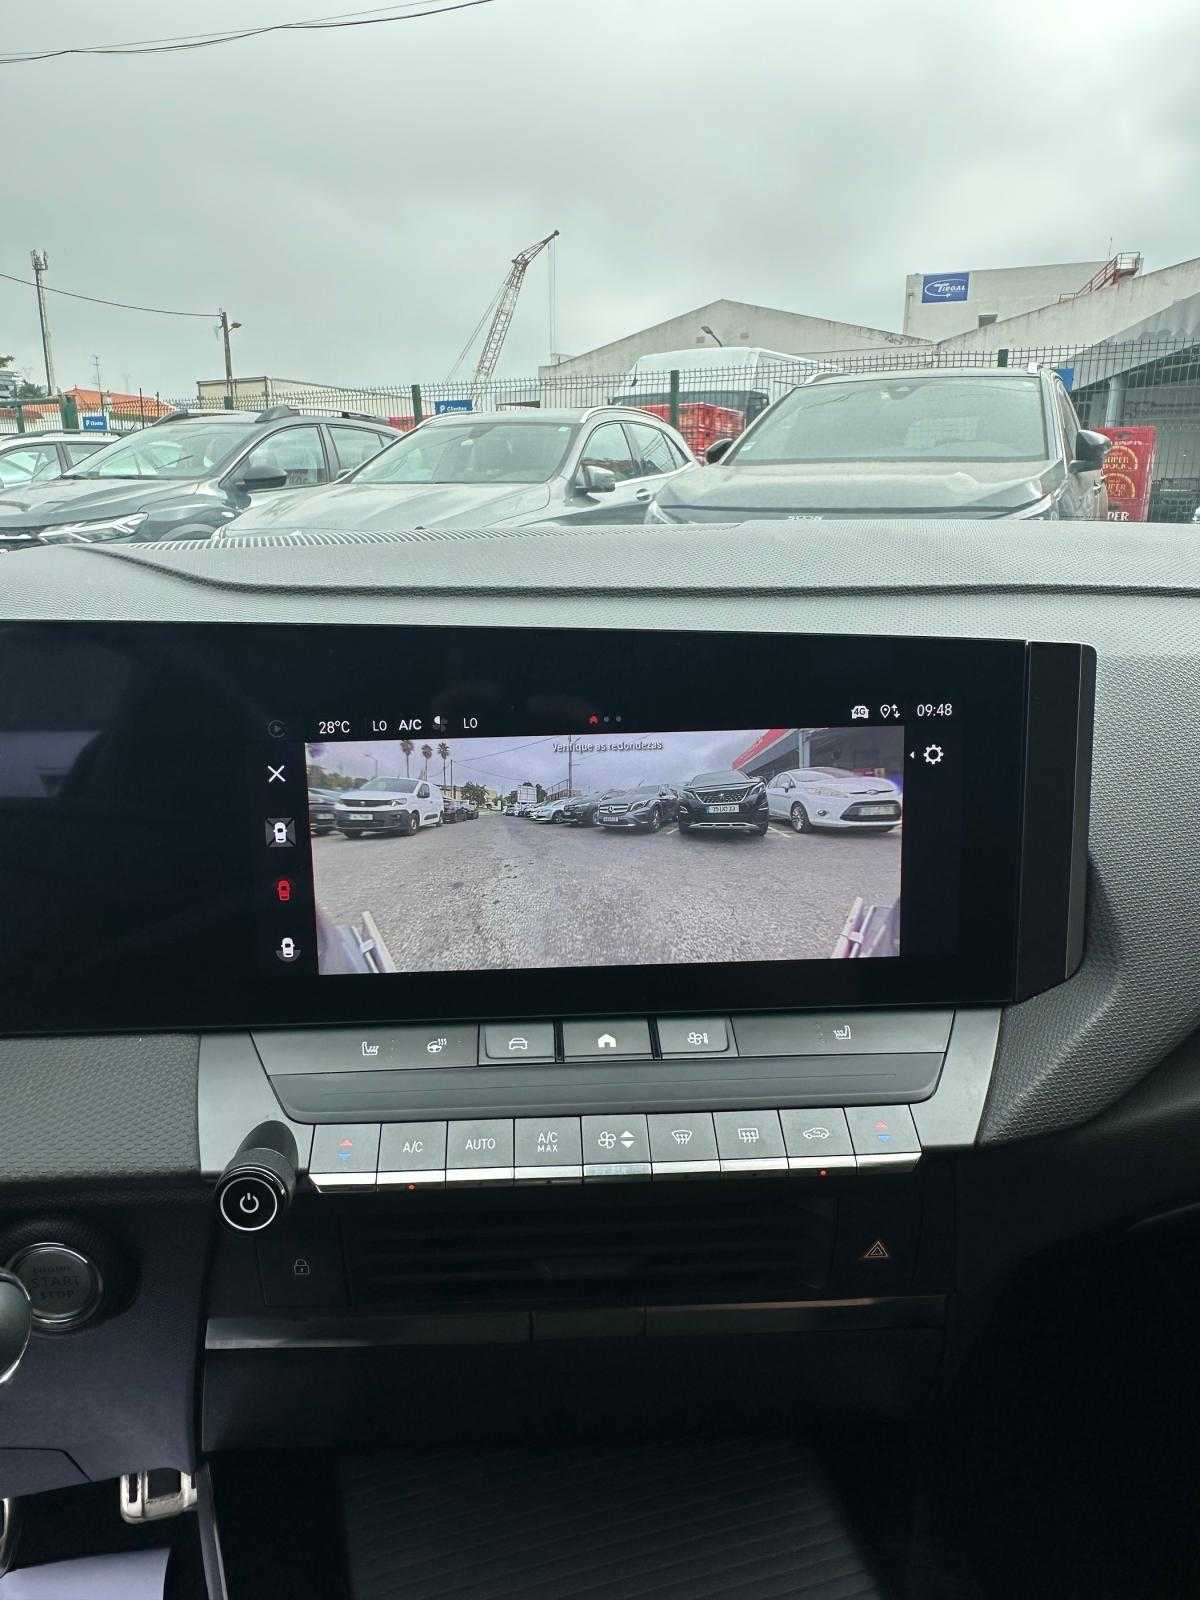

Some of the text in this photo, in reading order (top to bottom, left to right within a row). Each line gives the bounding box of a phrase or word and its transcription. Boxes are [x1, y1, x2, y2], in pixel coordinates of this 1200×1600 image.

[917, 703, 953, 717] 09:48
[318, 717, 478, 734] 28°C LO A/C LO
[537, 1130, 558, 1144] A/C
[402, 1141, 424, 1154] A/C
[465, 1138, 496, 1151] AUTO
[537, 1145, 559, 1153] MAX
[31, 1275, 81, 1289] START
